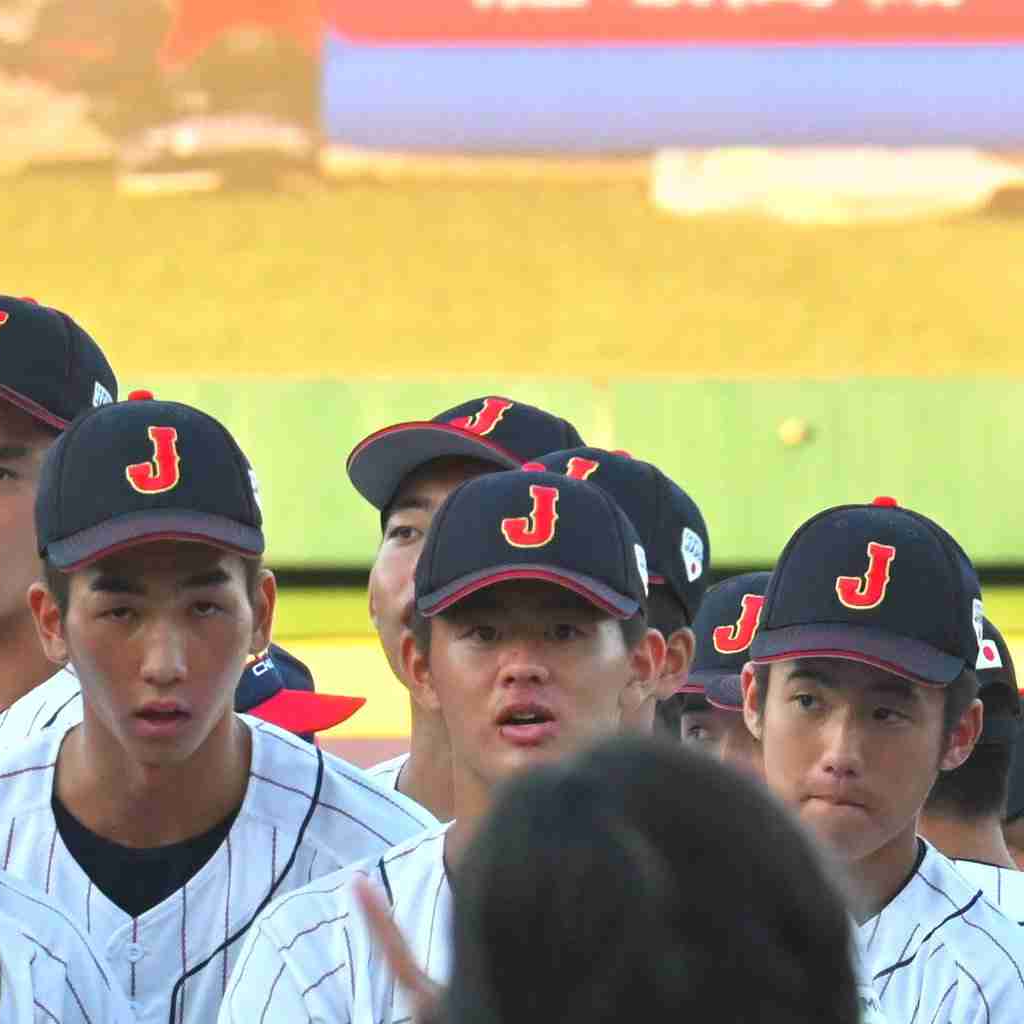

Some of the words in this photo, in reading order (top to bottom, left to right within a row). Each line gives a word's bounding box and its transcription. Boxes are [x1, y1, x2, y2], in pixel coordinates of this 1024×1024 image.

[450, 396, 513, 436] J
[125, 425, 182, 495] J
[500, 484, 561, 548] J
[834, 540, 897, 610] J
[711, 592, 765, 655] J
